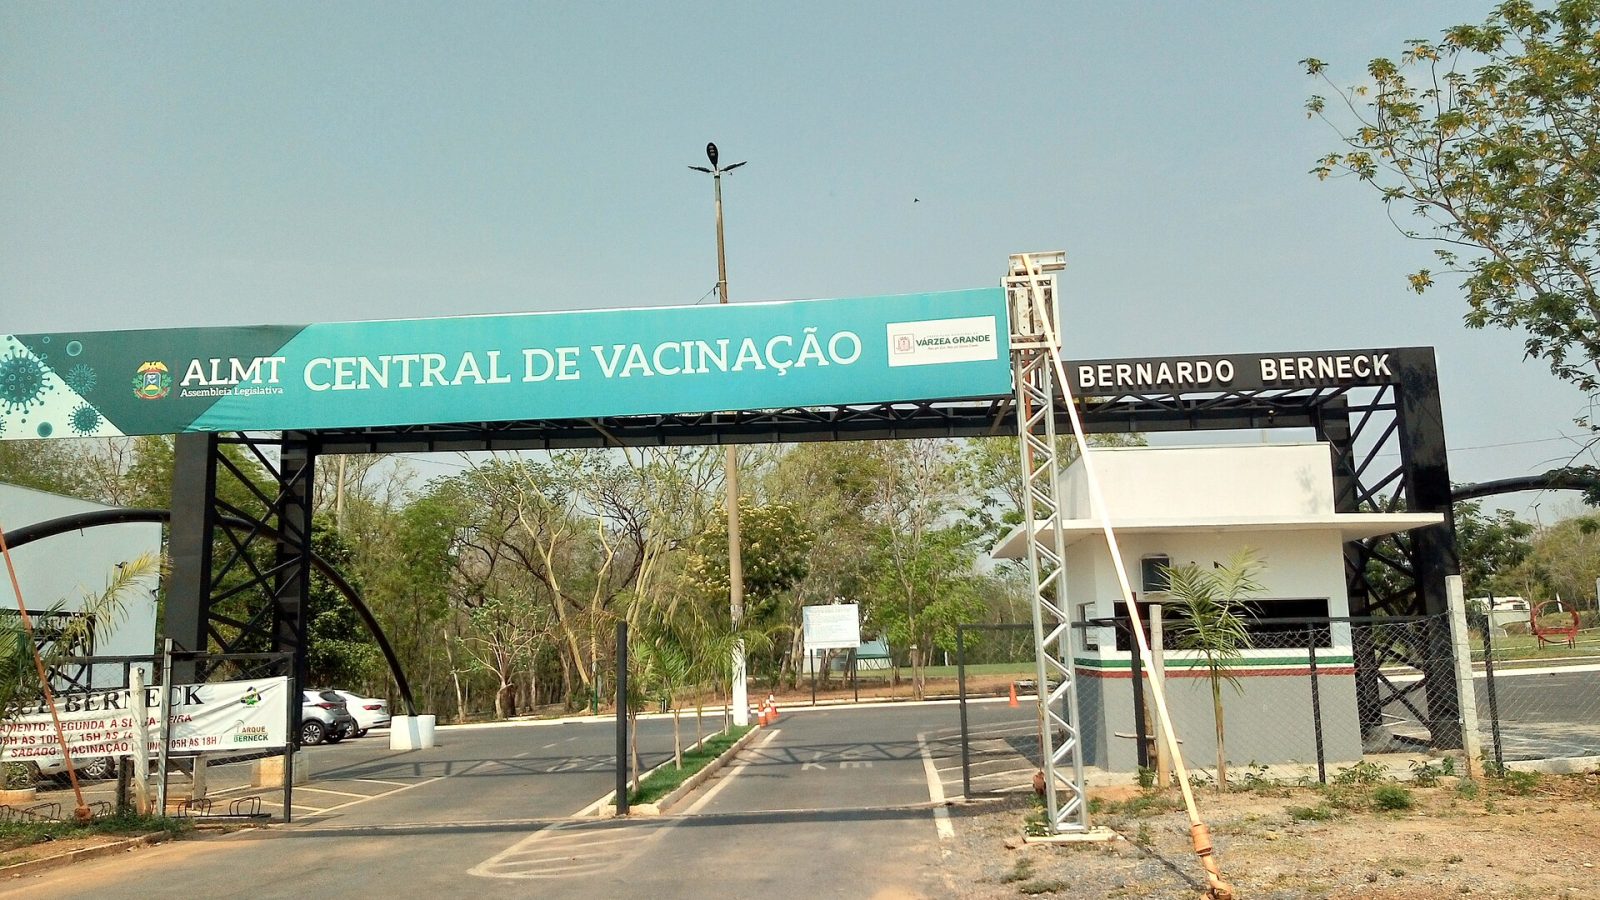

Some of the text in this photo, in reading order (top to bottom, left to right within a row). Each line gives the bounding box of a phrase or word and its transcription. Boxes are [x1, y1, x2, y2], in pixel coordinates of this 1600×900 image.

[915, 337, 951, 346] VÁRZEA
[952, 334, 991, 344] GRANDE
[303, 327, 862, 391] CENTRAL DE VACINAÇÃO
[180, 356, 286, 387] ALMT
[1078, 359, 1234, 388] BERNARDO
[1260, 353, 1392, 381] BERNECK
[180, 385, 284, 397] Assembleia Legislativa
[54, 720, 105, 731] EGUNDA
[79, 732, 101, 742] 15H
[171, 738, 187, 748] 05H
[202, 736, 217, 745] 18H
